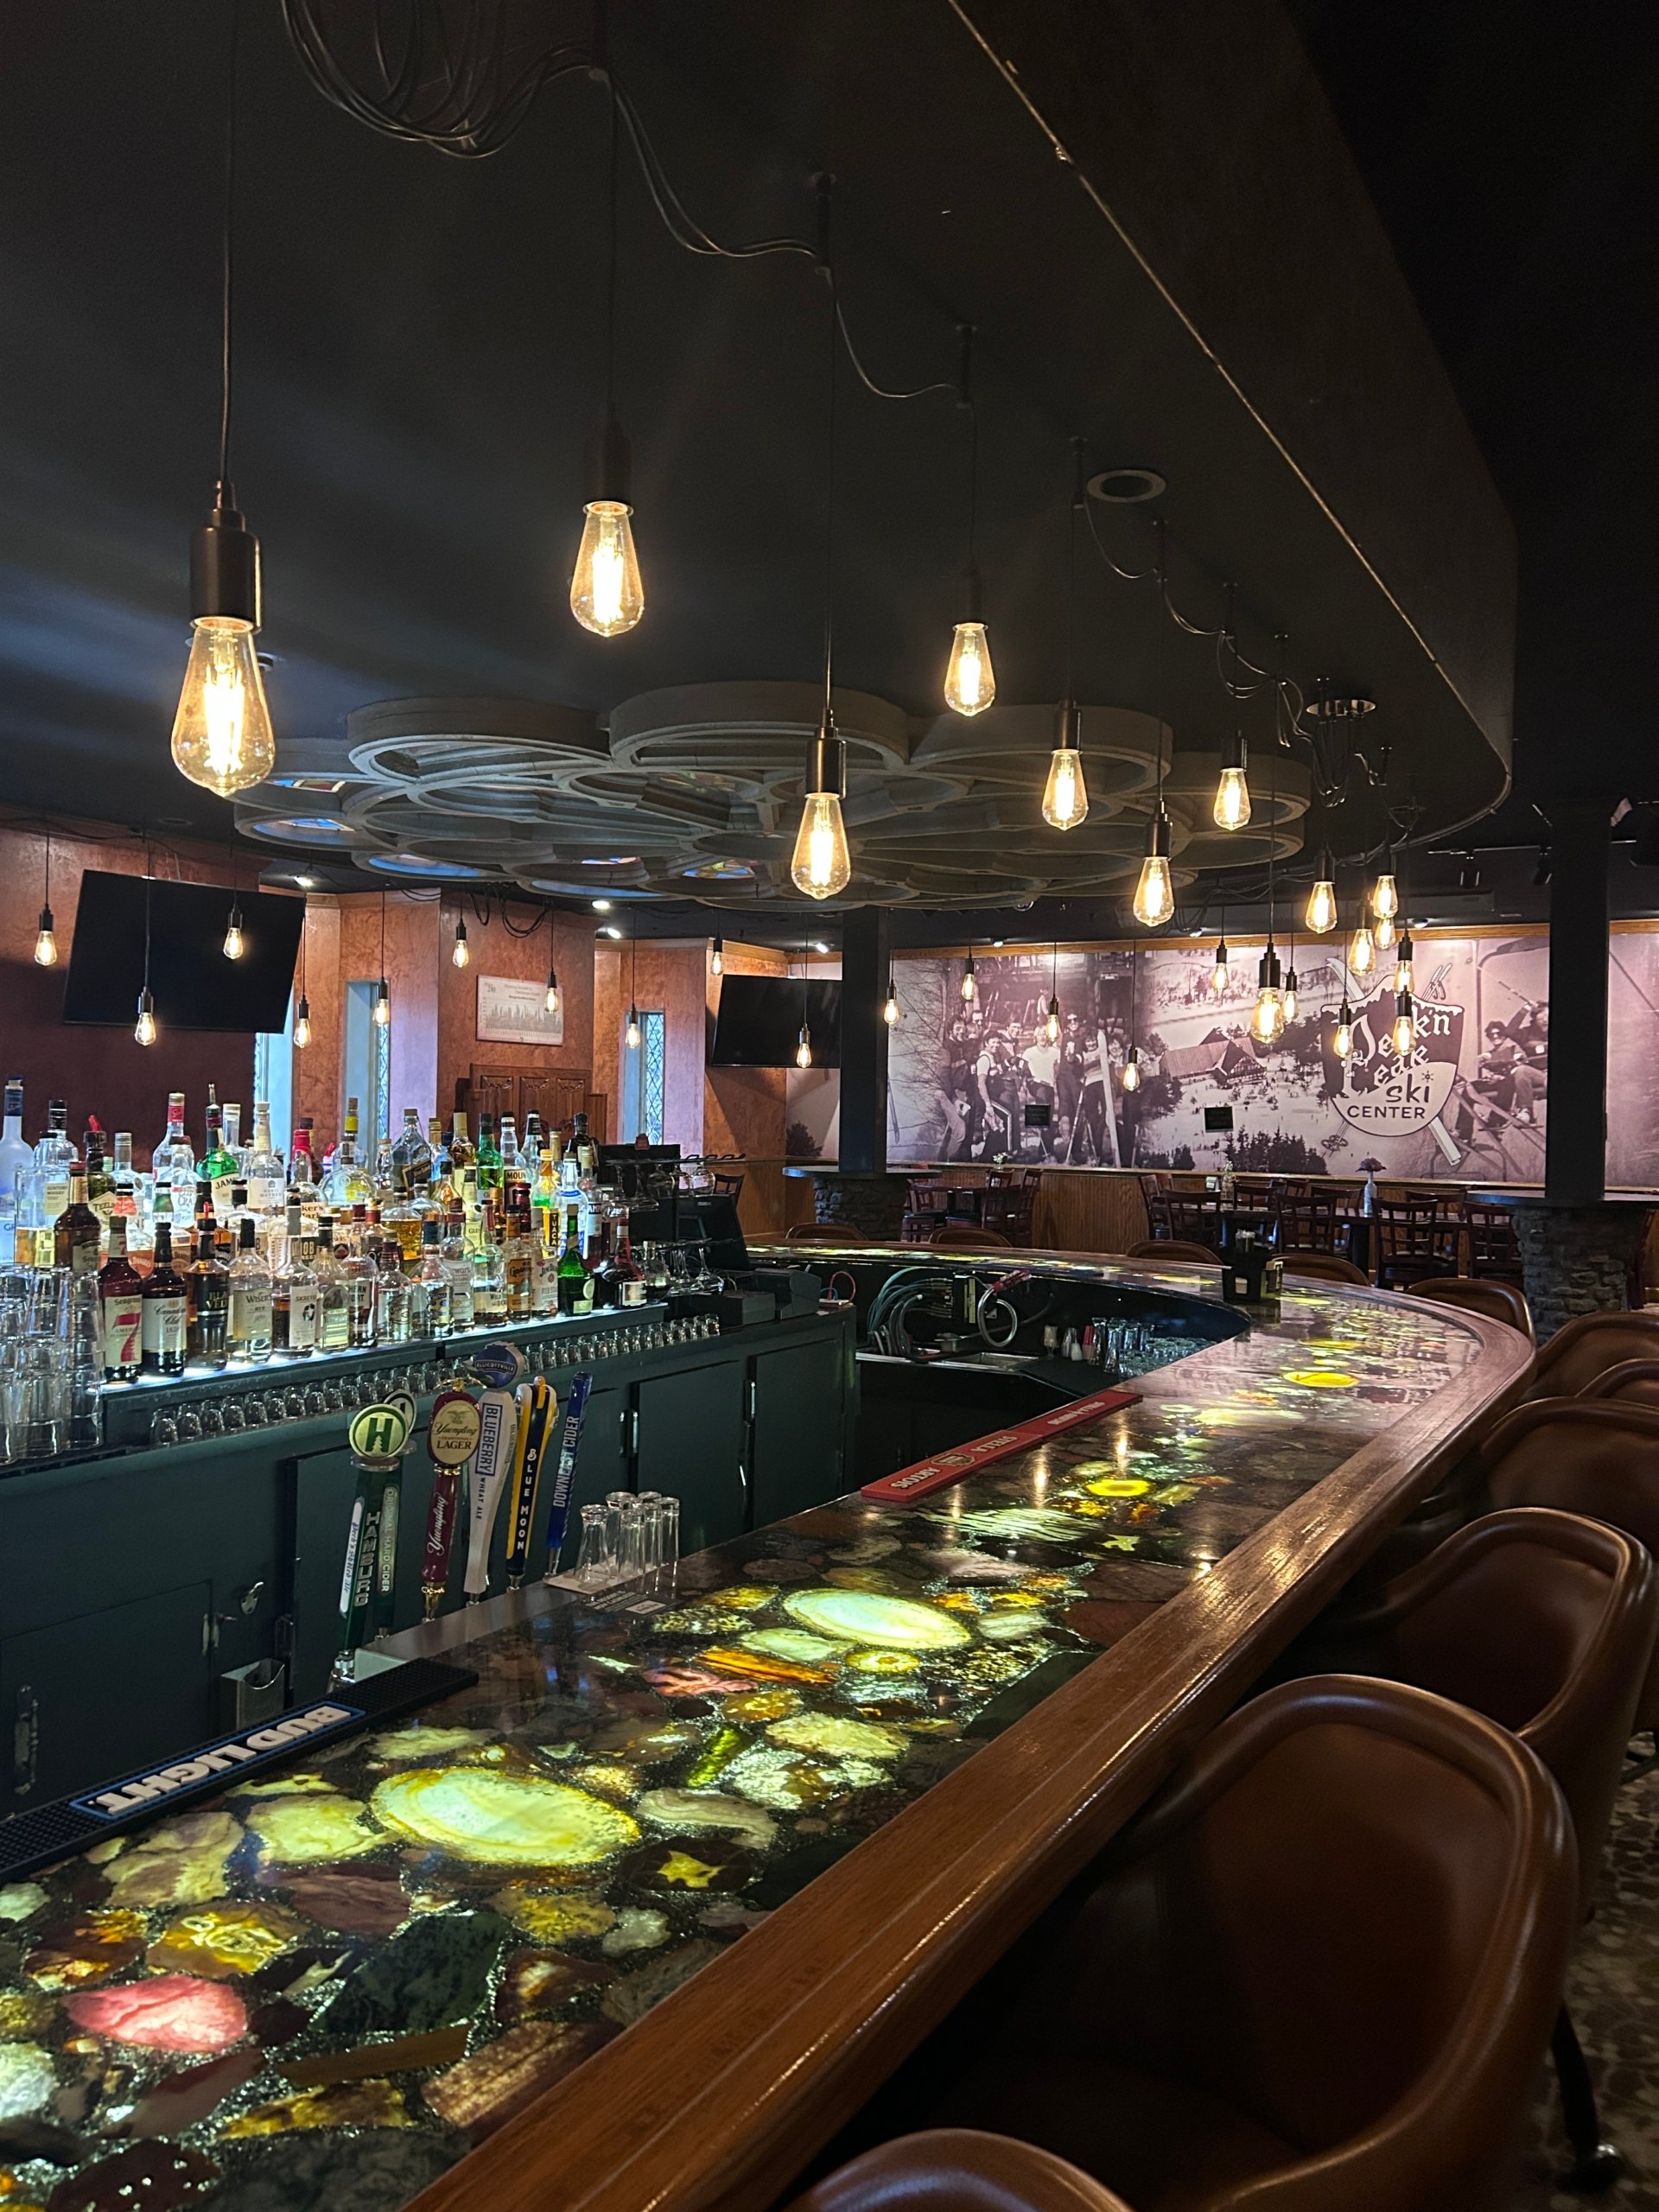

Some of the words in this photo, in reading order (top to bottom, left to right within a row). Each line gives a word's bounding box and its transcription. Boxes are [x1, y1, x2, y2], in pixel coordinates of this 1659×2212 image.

[1347, 1105, 1426, 1119] CENTER
[111, 1312, 142, 1363] 7
[476, 1362, 514, 1372] ELLICOTTVILLE
[365, 1417, 394, 1453] H
[433, 1421, 479, 1436] Yuengling
[436, 1440, 472, 1450] LAGER
[480, 1406, 499, 1473] BLUEBERRY
[563, 1415, 580, 1448] CIDER
[970, 1434, 1018, 1452] STELLA
[523, 1448, 537, 1497] BLUE
[891, 1466, 942, 1489] ARTOIS
[477, 1478, 486, 1503] WHEAT
[427, 1492, 448, 1556] Yuengling
[518, 1504, 529, 1550] MOON
[353, 1511, 381, 1607] HAMBURG
[382, 1535, 392, 1561] HARD
[380, 1564, 391, 1592] CIDER
[246, 1705, 351, 1751] BUD
[95, 1744, 257, 1815] LIGHT
